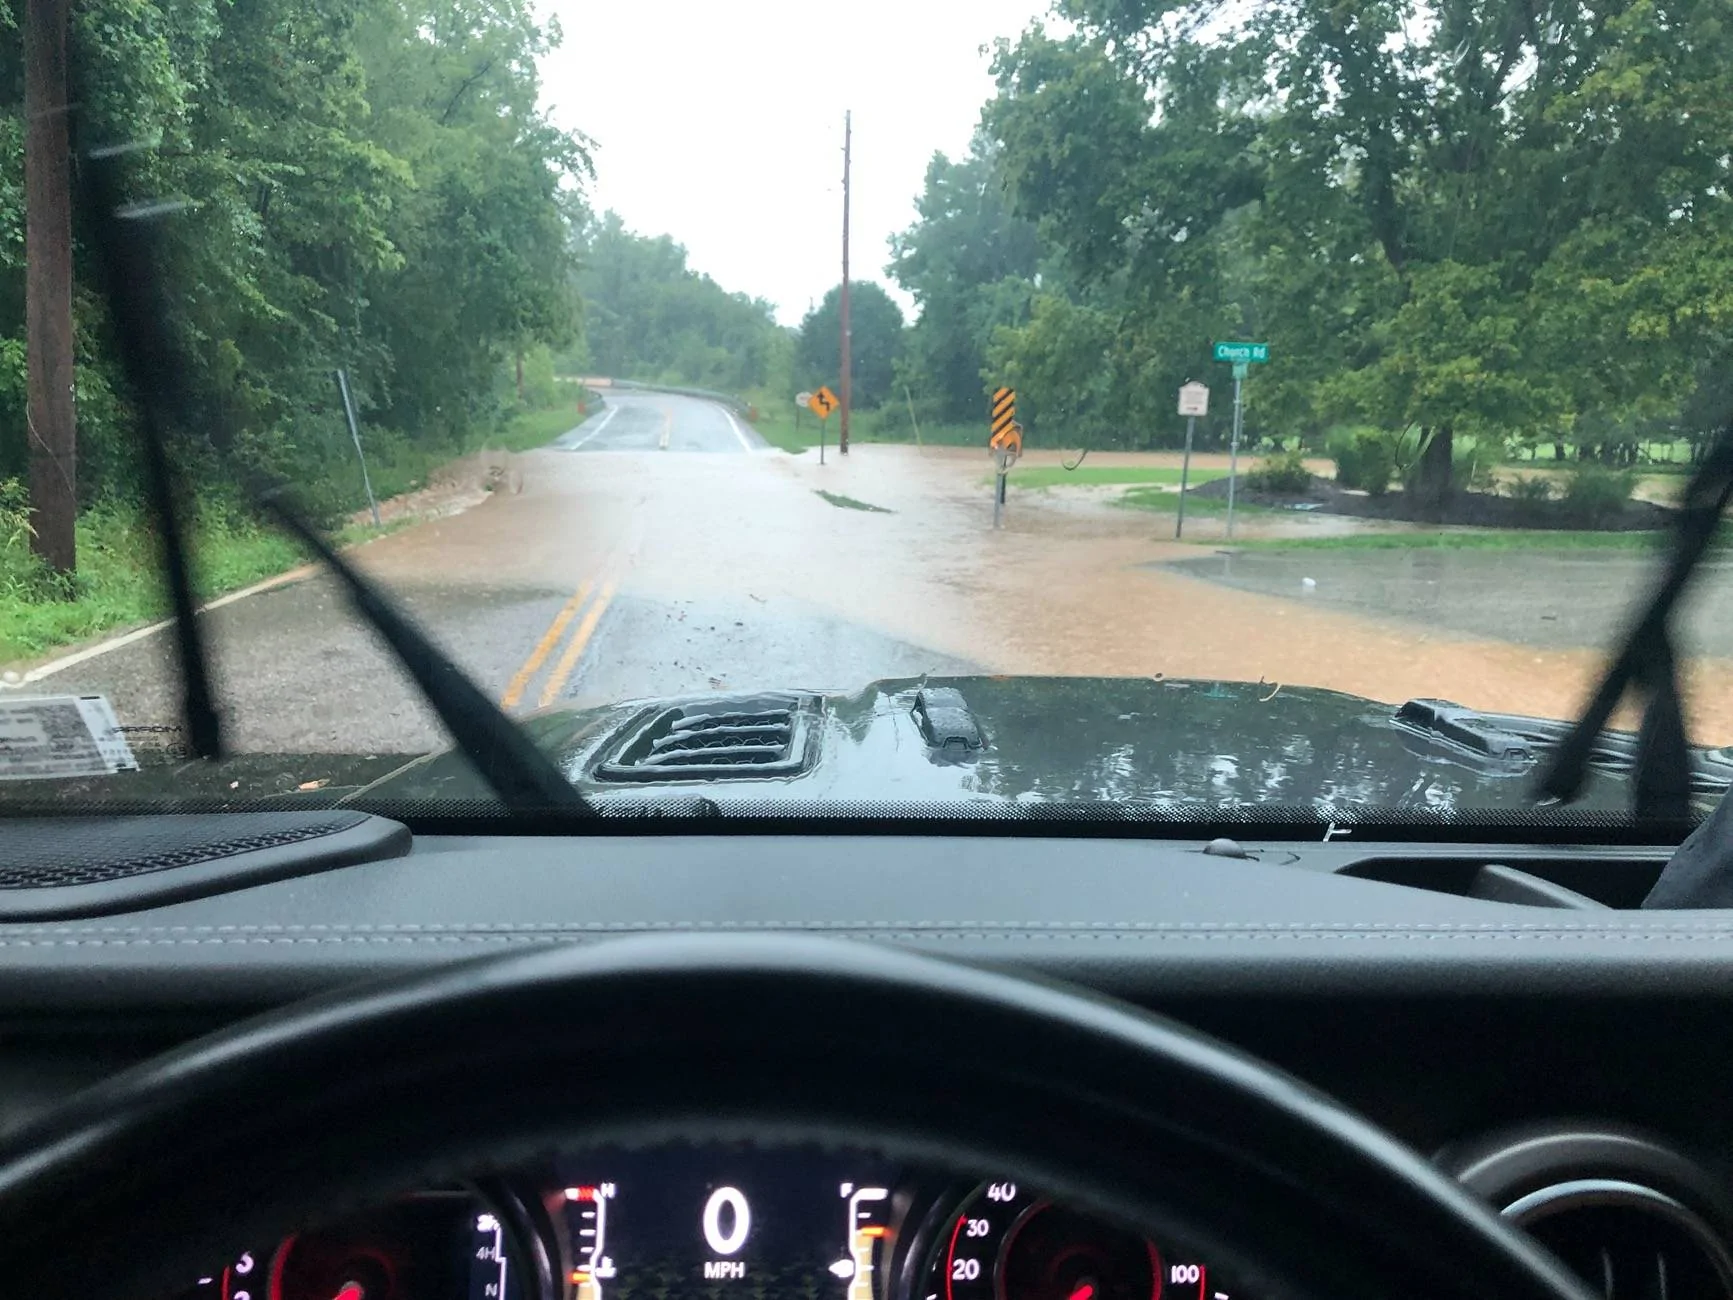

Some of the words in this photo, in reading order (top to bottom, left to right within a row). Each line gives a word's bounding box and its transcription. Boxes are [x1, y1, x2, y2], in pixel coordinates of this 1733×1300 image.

[987, 1182, 1016, 1202] 40
[703, 1186, 750, 1255] 0
[966, 1219, 990, 1237] 30
[476, 1246, 496, 1260] 4H
[704, 1261, 745, 1279] MPH
[952, 1258, 980, 1281] 20
[1171, 1264, 1200, 1284] 100
[485, 1282, 498, 1297] N
